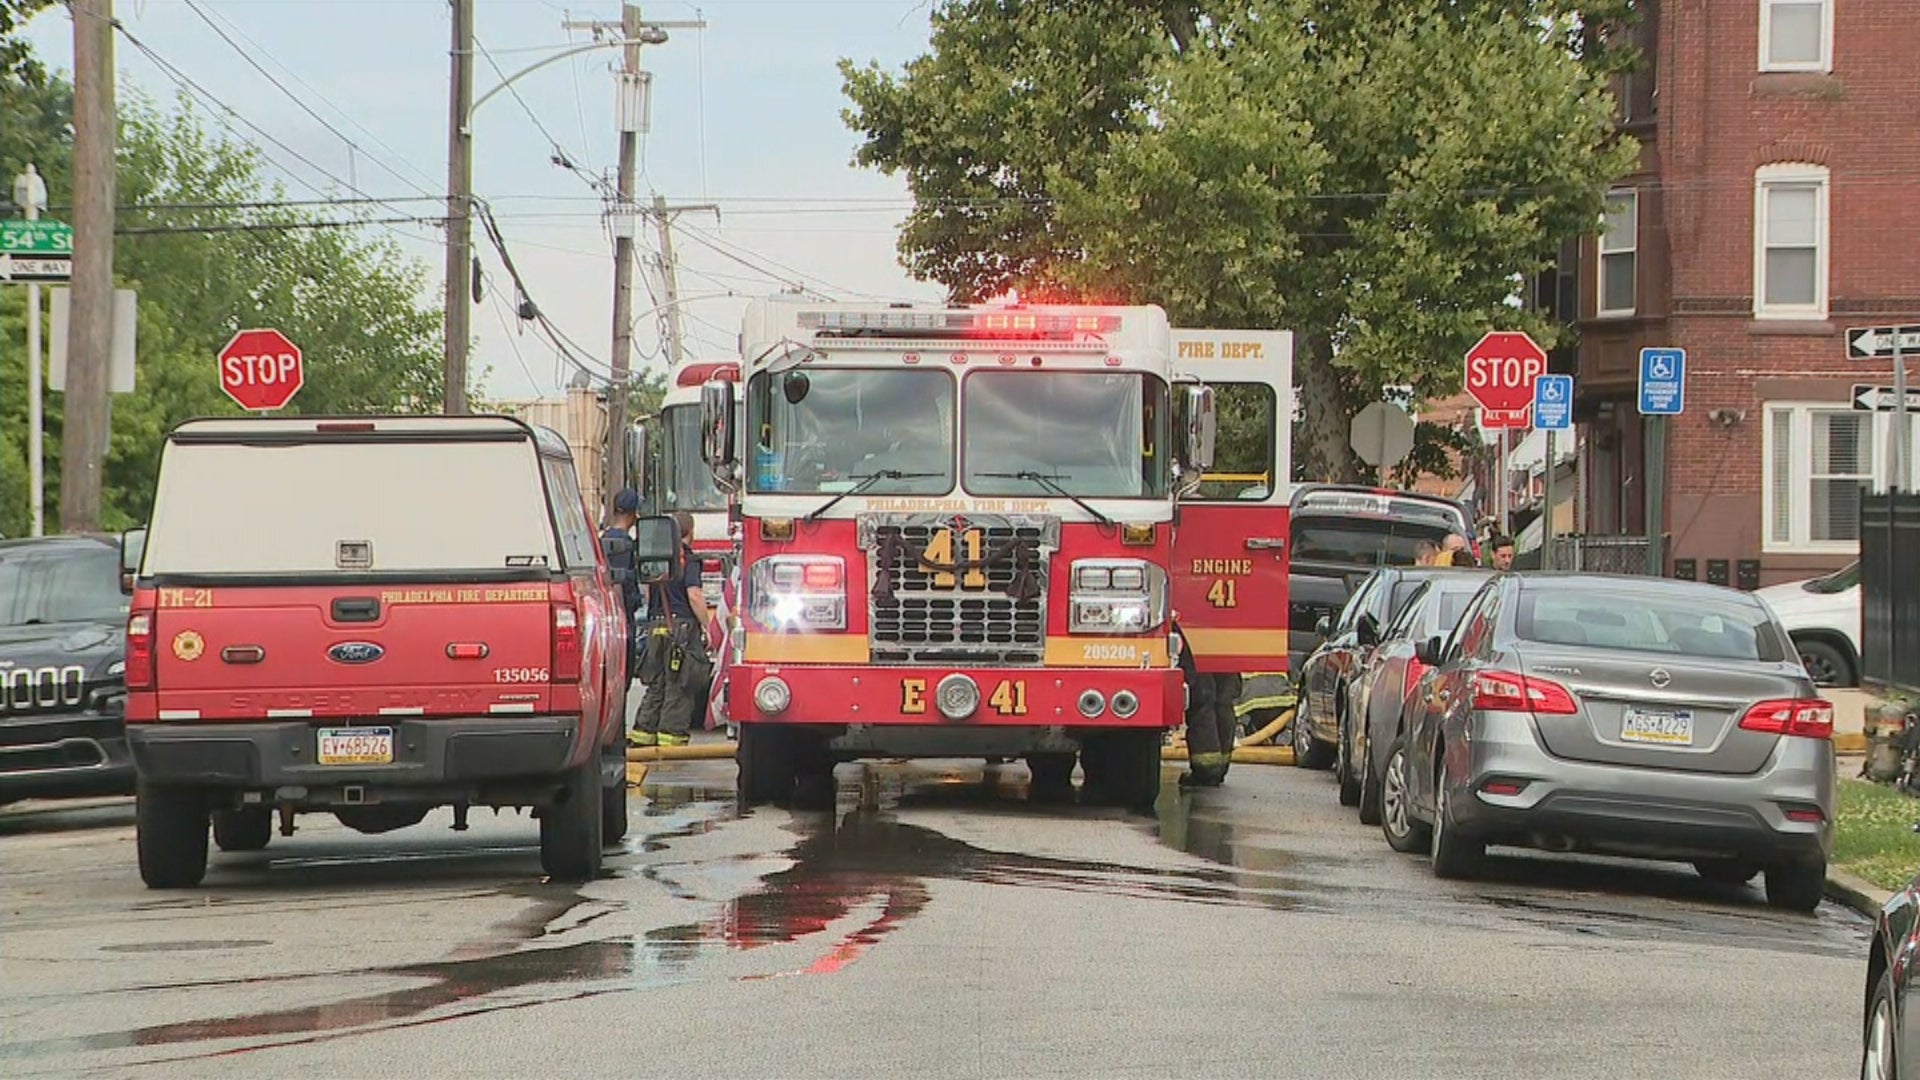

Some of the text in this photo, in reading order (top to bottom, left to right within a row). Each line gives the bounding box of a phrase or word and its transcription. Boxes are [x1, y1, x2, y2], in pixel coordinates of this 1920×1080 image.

[3, 230, 48, 248] 54th
[11, 260, 66, 272] ONE WAY
[1178, 342, 1264, 358] FIRE DEPT.
[225, 354, 296, 386] STOP
[1470, 357, 1540, 388] STOP
[867, 500, 1050, 511] PHILADELPHIA FIRE DEPT.
[918, 529, 985, 587] 41
[1192, 559, 1252, 575] ENGINE
[159, 588, 213, 608] FM-21
[382, 588, 549, 603] PHILADELPHIA FIRE DEPARTMENT
[1207, 579, 1236, 608] 41
[1083, 643, 1137, 661] 205204
[493, 668, 549, 683] 135056
[903, 679, 1028, 715] E 41
